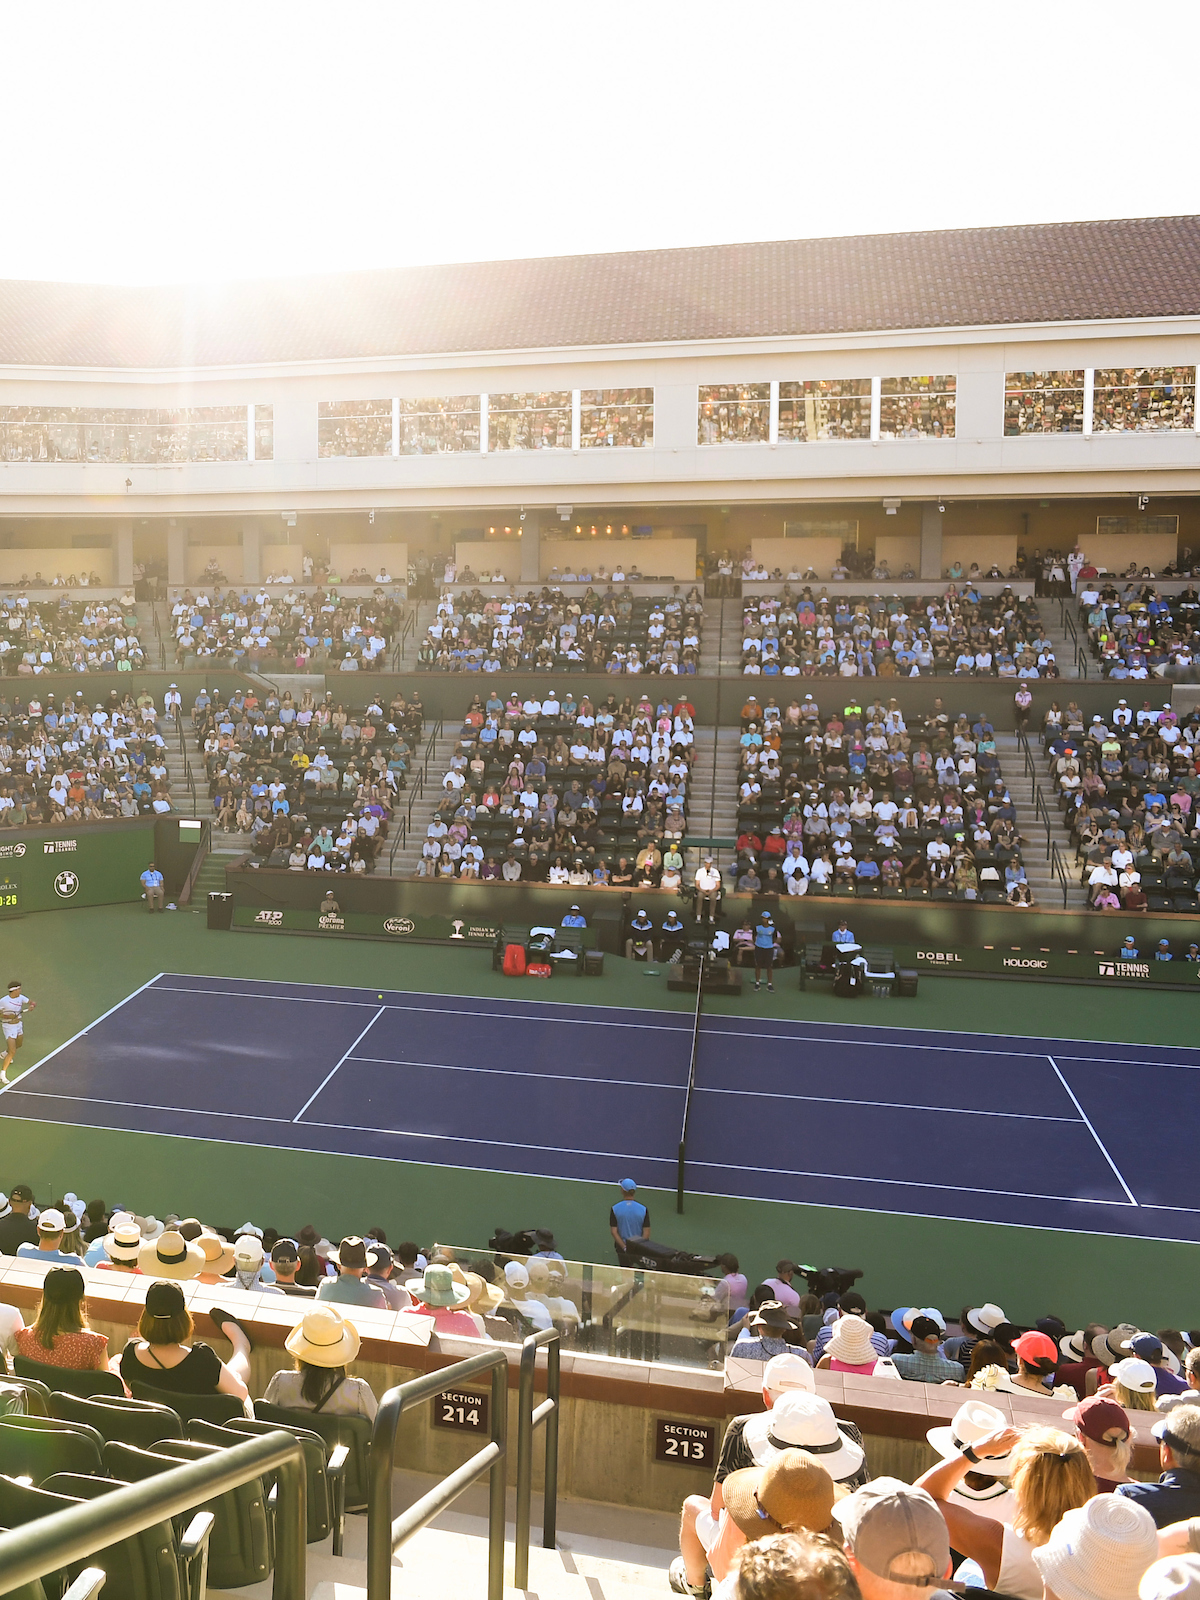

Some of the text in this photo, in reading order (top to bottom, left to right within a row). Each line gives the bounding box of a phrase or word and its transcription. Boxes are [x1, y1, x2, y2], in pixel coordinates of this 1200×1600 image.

[55, 840, 77, 848] TENNIS
[255, 910, 284, 920] ATP
[319, 916, 345, 924] Corona
[387, 922, 411, 932] Veroni
[916, 951, 962, 962] DOBEL
[1003, 958, 1048, 969] HOLOGIC
[1115, 962, 1149, 973] TENNIS
[1116, 971, 1150, 979] CHANNEL
[639, 1256, 656, 1267] ATP
[441, 1392, 482, 1406] SECTION
[442, 1405, 480, 1426] 214
[663, 1424, 708, 1439] SECTION
[664, 1437, 705, 1460] 213
